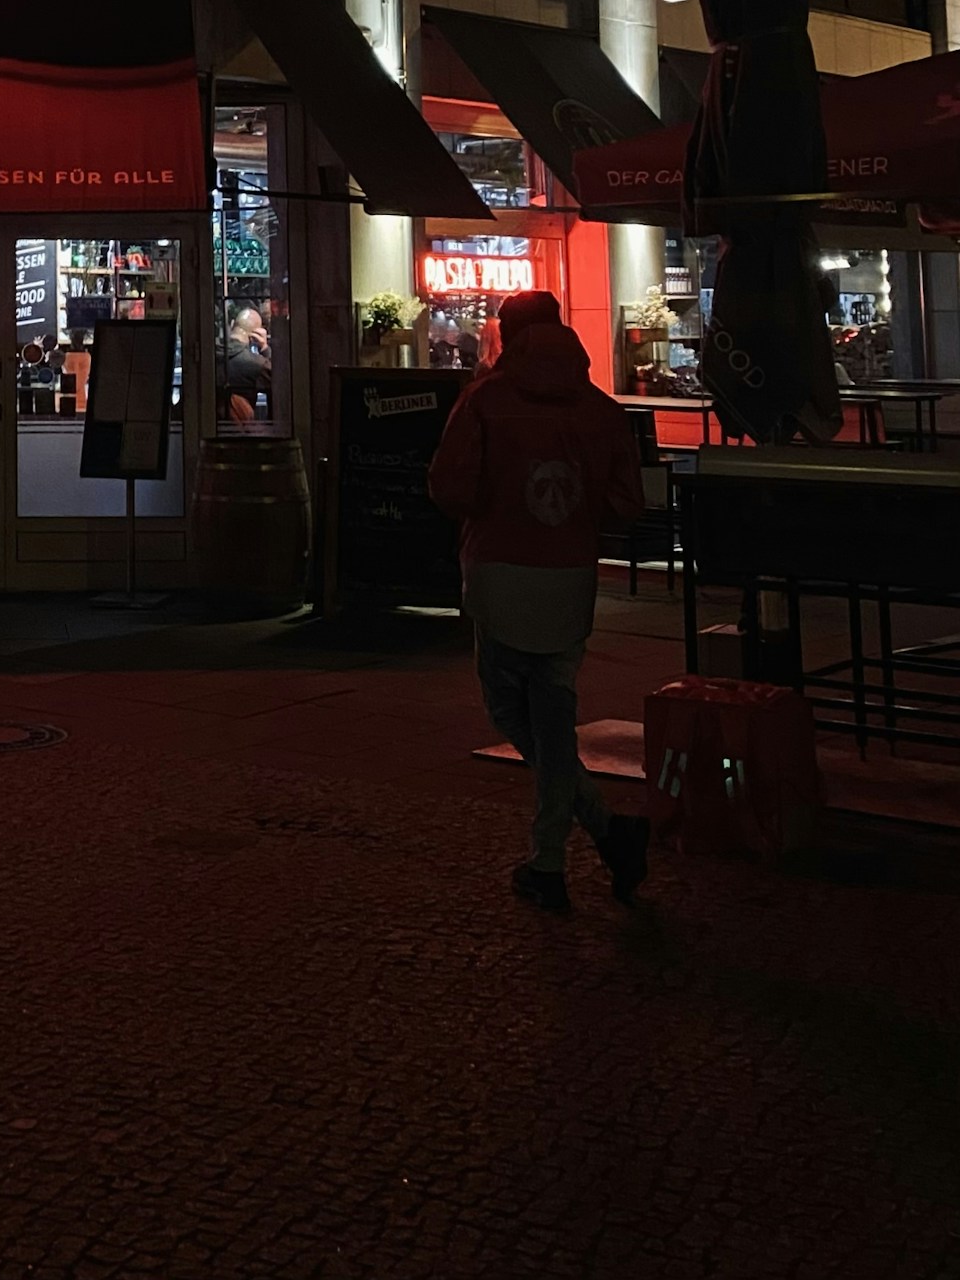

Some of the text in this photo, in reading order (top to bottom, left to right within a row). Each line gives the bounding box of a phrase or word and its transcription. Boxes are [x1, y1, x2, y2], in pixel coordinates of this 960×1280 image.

[55, 168, 102, 185] FÜR
[114, 170, 175, 185] ALLE
[607, 170, 650, 187] DER
[380, 395, 433, 413] BERLINER
